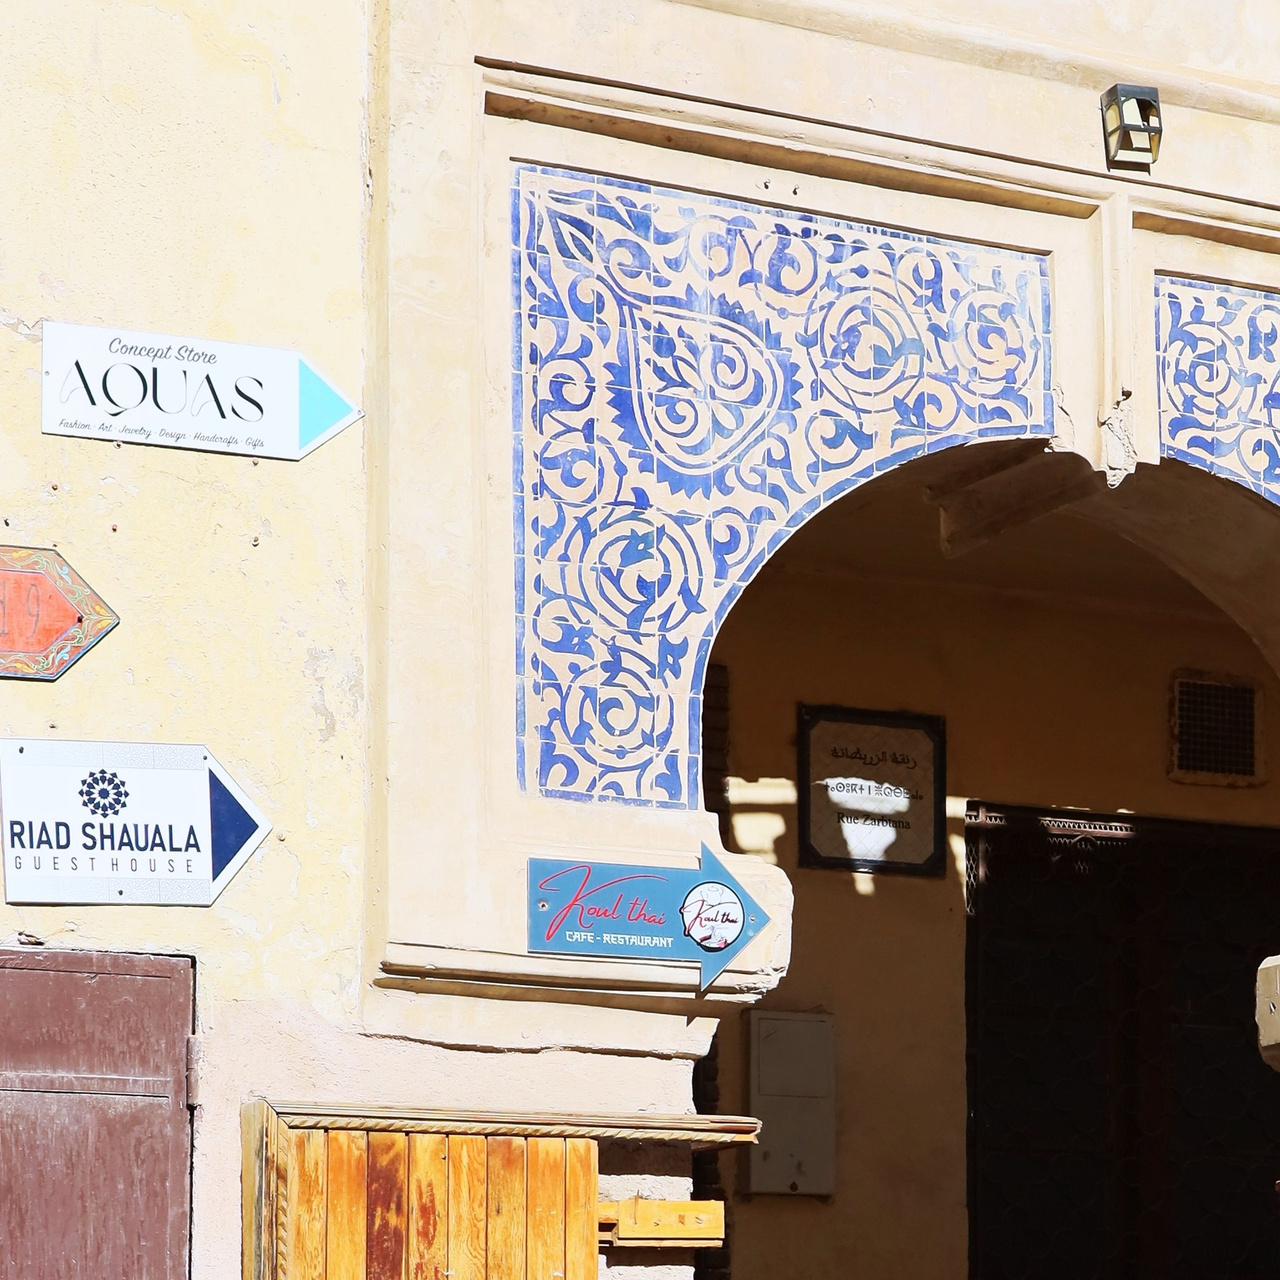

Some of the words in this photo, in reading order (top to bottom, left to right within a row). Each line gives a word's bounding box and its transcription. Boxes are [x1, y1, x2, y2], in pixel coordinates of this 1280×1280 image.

[108, 337, 172, 362] Concept
[175, 345, 218, 364] Store
[59, 359, 264, 422] AQUAS
[58, 419, 91, 430] Fashion
[98, 422, 113, 432] Art
[119, 425, 152, 440] Jewelry
[159, 428, 187, 442] Design
[193, 432, 238, 447] Handcrafts
[245, 437, 264, 450] Gifts
[9, 820, 71, 850] RIAD
[81, 822, 201, 852] SHAUALA
[837, 812, 859, 825] Rue
[862, 813, 910, 830] Zarbtana
[538, 864, 669, 940] Koul
[628, 896, 667, 926] thai
[565, 931, 595, 943] CAFE
[602, 933, 674, 948] RESTAURANT
